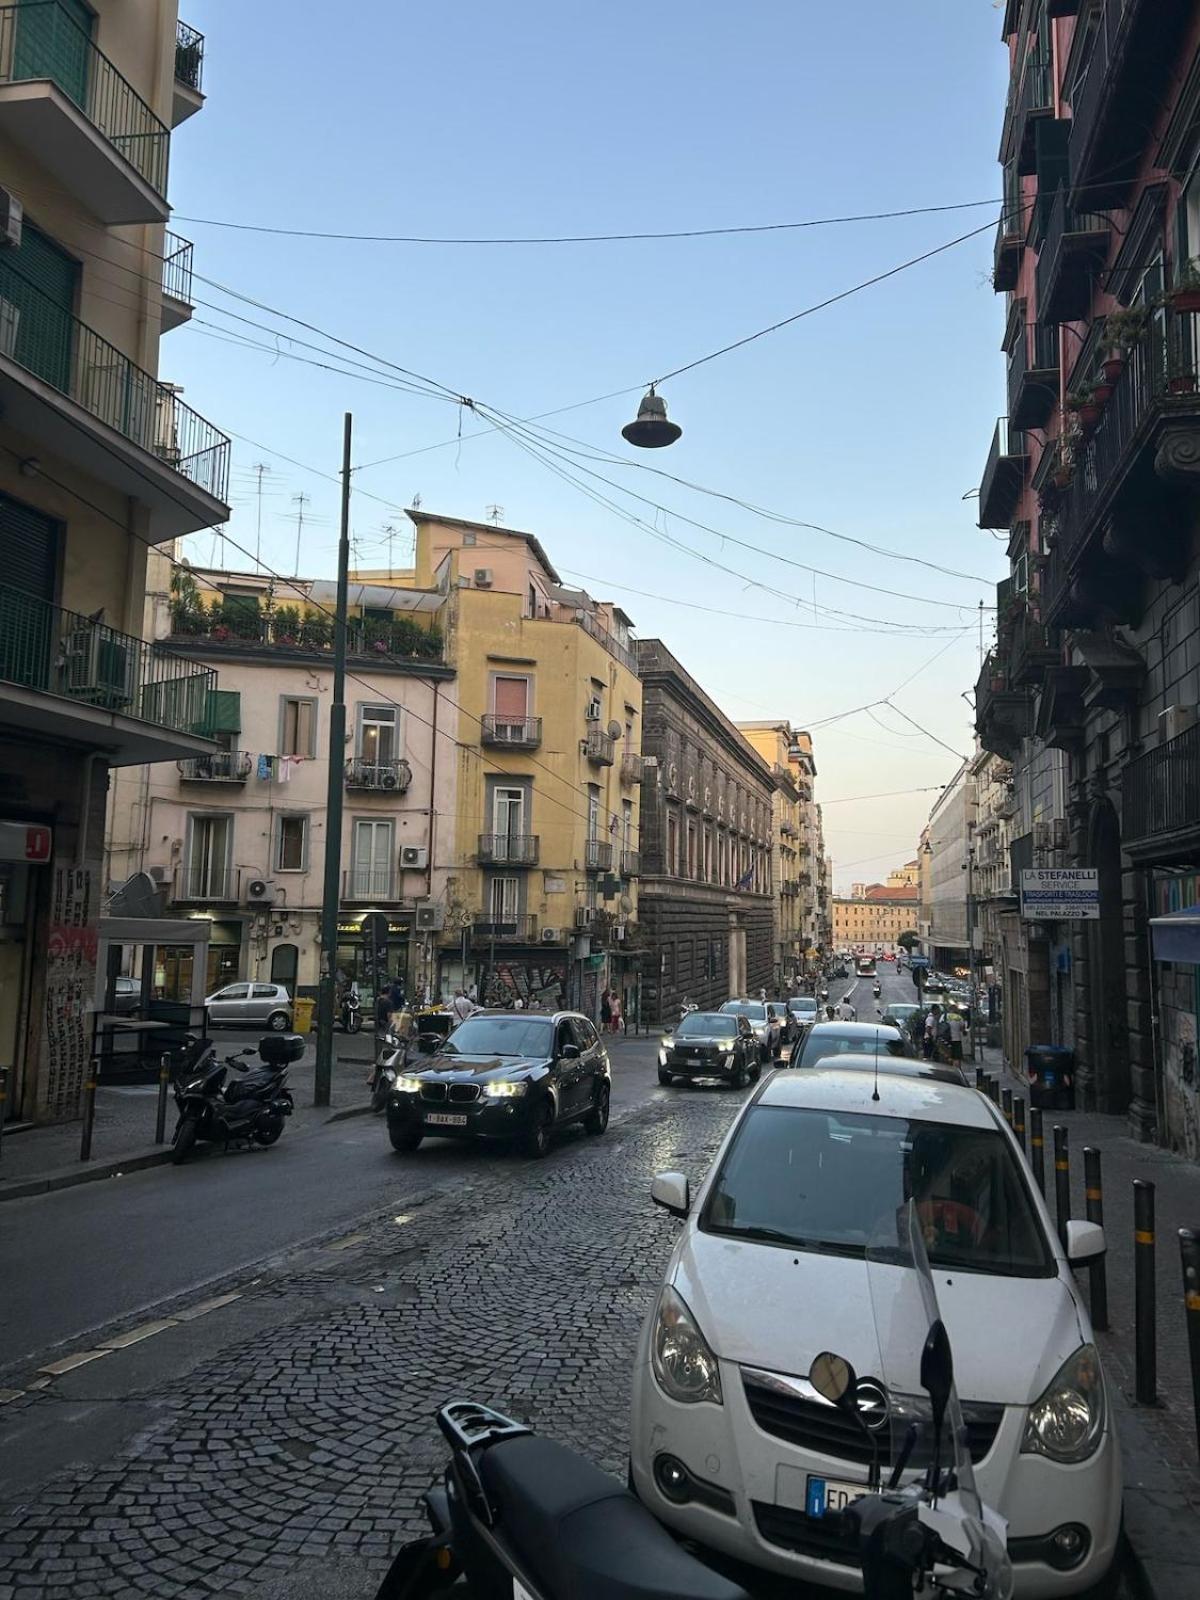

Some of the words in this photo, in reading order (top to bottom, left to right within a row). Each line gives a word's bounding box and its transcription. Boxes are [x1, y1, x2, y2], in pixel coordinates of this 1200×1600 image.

[1024, 871, 1036, 880] LA
[1038, 871, 1096, 880] STEFANELLI
[1041, 881, 1080, 889] SERVICE
